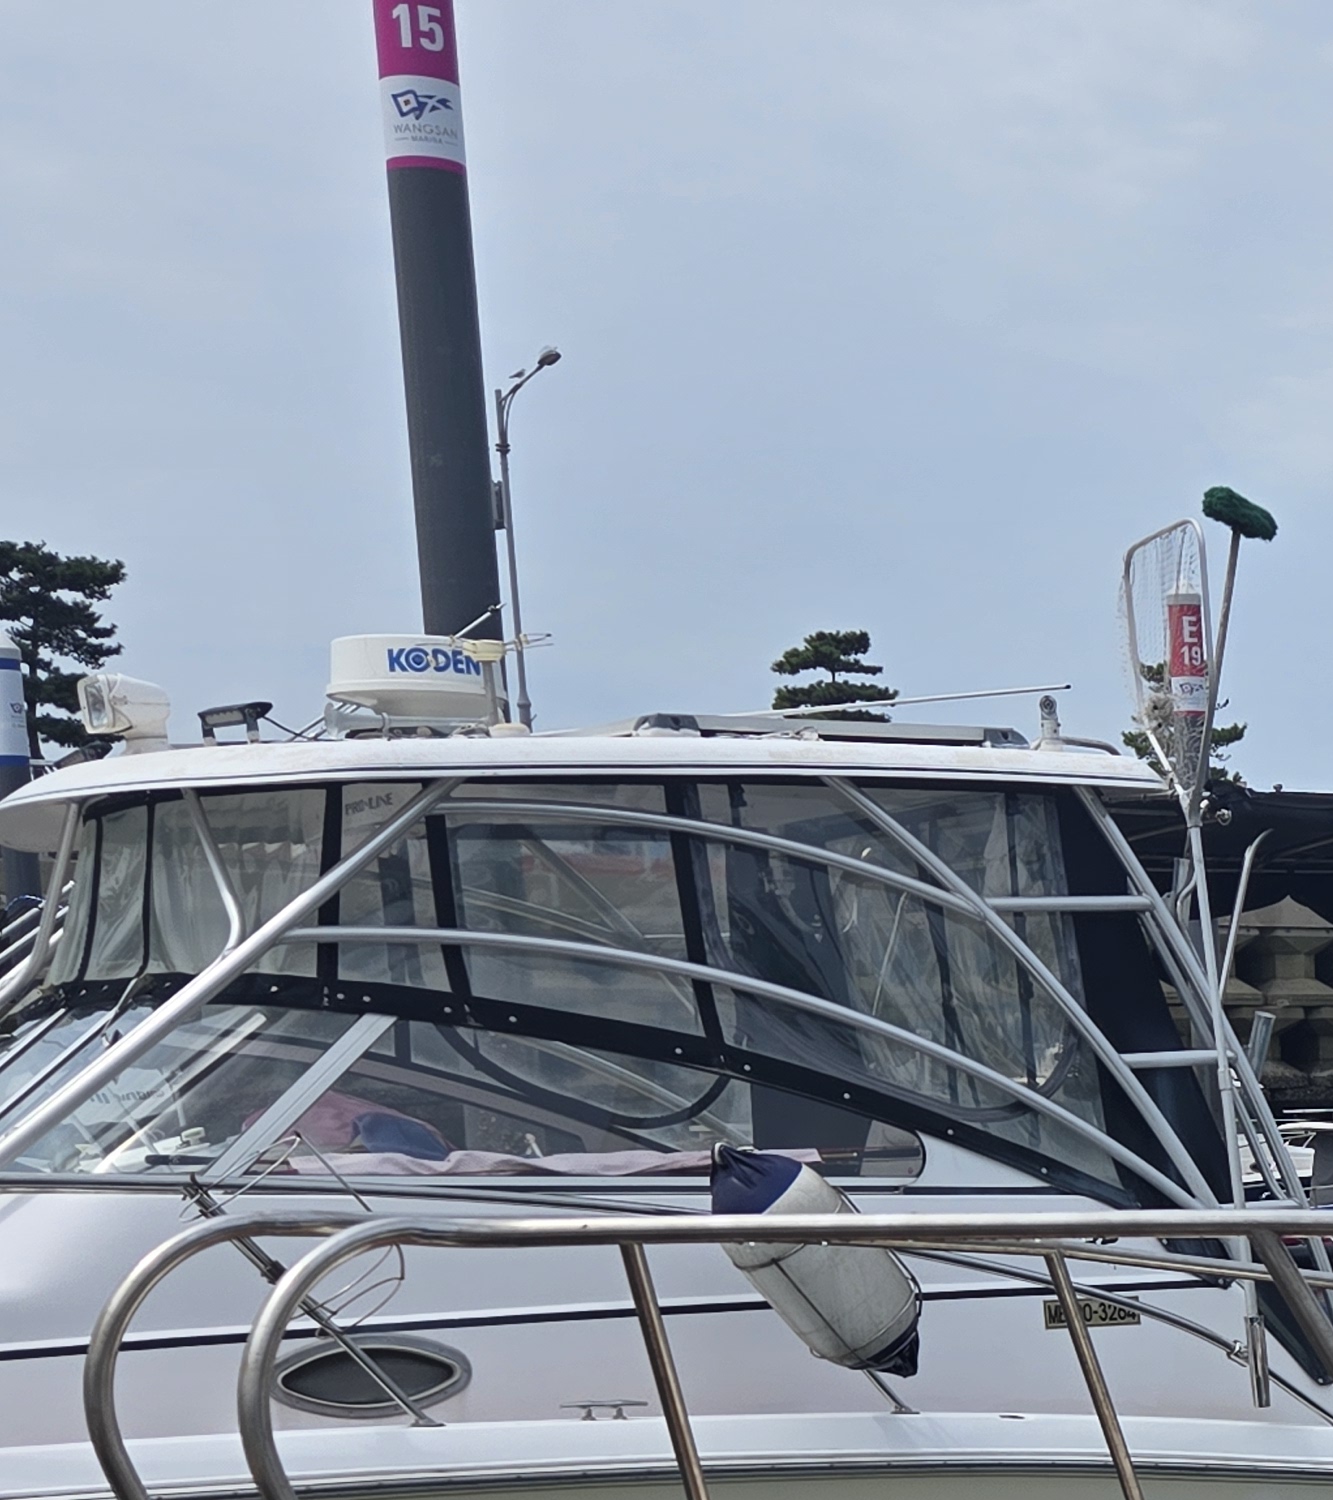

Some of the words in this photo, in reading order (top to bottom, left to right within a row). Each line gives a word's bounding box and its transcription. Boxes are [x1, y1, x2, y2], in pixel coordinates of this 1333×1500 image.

[392, 3, 445, 52] 15
[393, 123, 459, 139] WANGSAN
[1182, 615, 1199, 643] E
[387, 647, 482, 676] KODEN
[1181, 645, 1202, 666] 19
